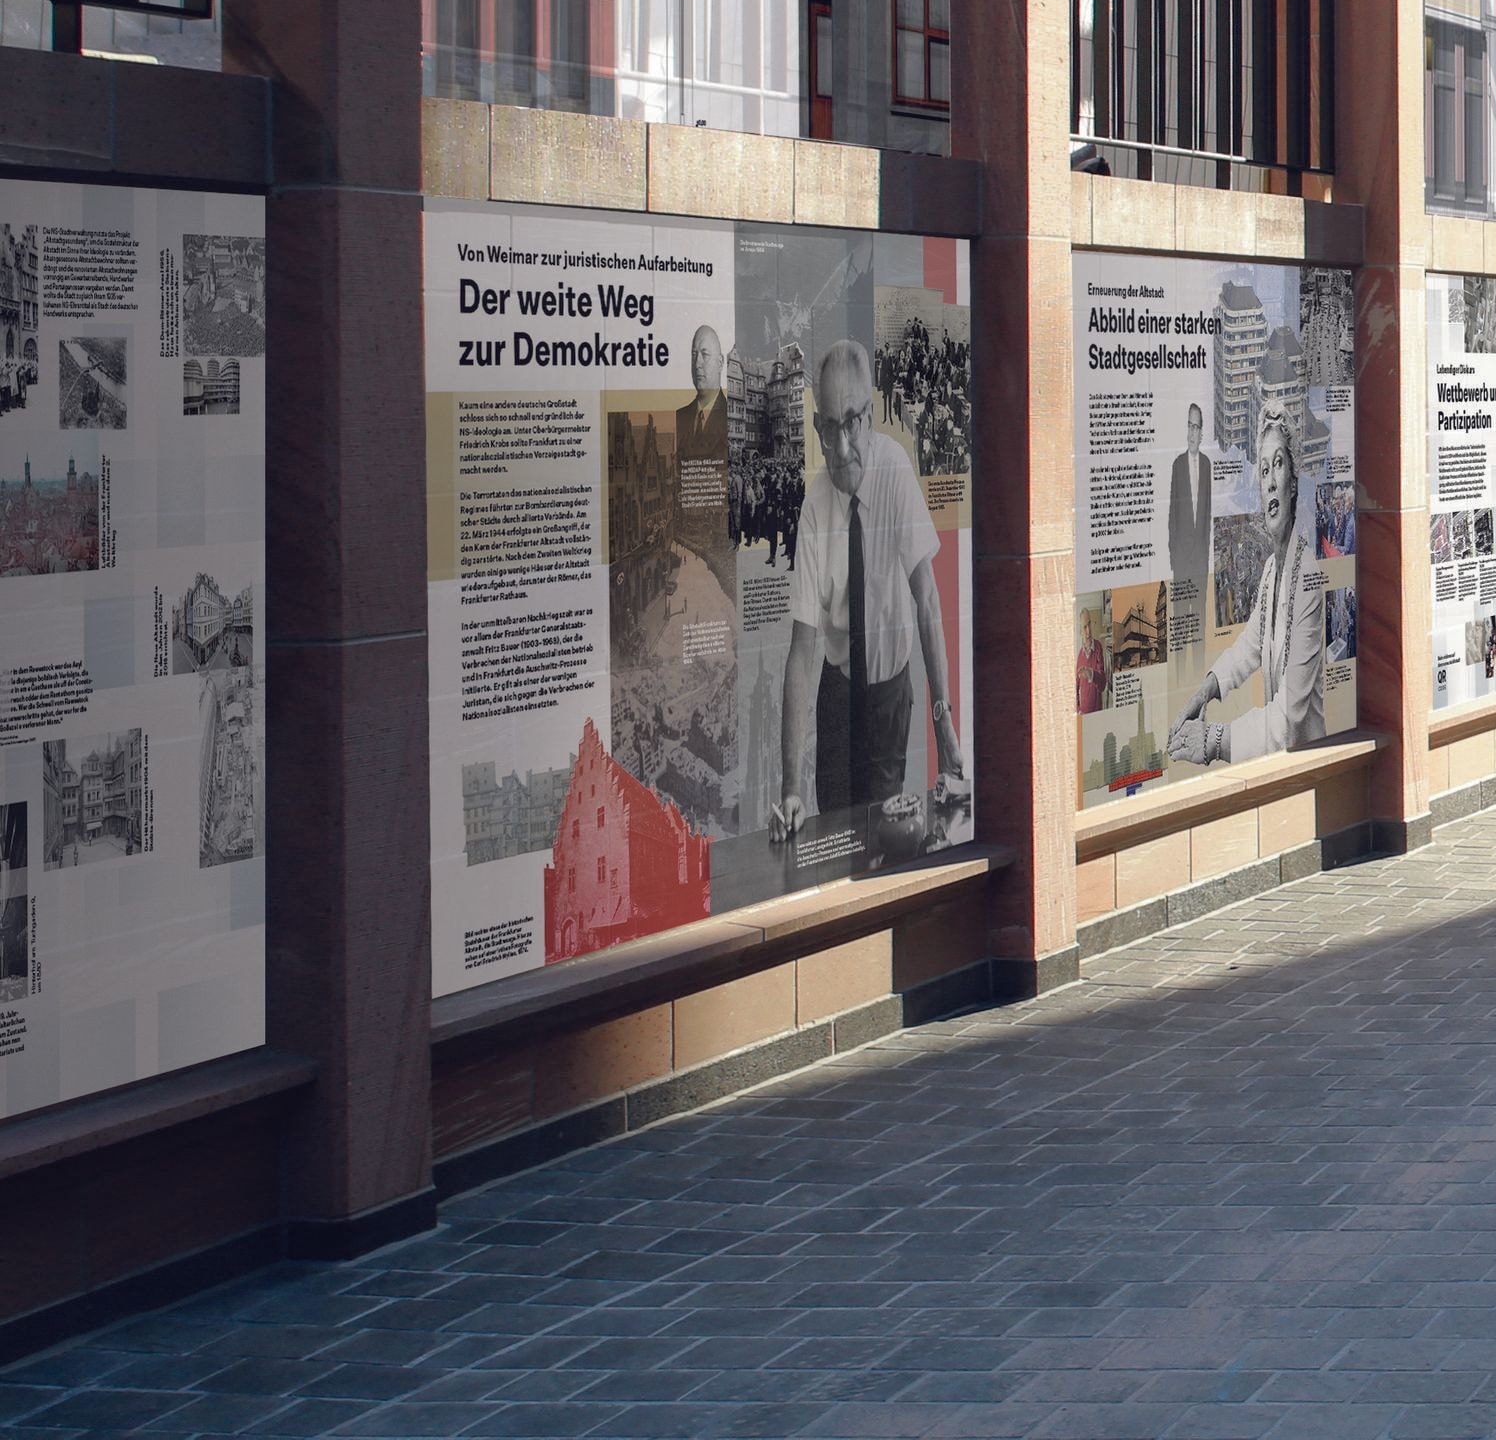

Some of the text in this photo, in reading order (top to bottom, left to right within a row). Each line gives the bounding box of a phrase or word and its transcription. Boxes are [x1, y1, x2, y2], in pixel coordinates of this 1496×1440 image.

[458, 244, 713, 276] Von Weimar zur juristischen Aufarbeitung
[1088, 282, 1164, 299] Erneuerung der Altstadt
[460, 278, 654, 326] Der weite Weg
[1088, 307, 1222, 334] Abbild einer starken
[459, 332, 669, 367] zur Demokratie
[1089, 344, 1206, 374] Stadtgesellschaft
[1437, 382, 1488, 402] Wettbewerb
[517, 400, 546, 408] deutsche
[547, 399, 577, 408] Großstadt
[459, 413, 484, 422] schloss
[485, 413, 499, 421] sich
[508, 412, 530, 421] schnell
[544, 412, 573, 422] gründlich
[574, 411, 584, 419] der
[1438, 410, 1492, 433] Partizipation
[459, 427, 502, 437] NS-Ideologie
[533, 425, 591, 435] Oberbürgermeister
[459, 440, 490, 448] Friedrich
[490, 440, 509, 448] Krebs
[510, 439, 528, 447] sollte
[529, 438, 558, 446] Frankfurt
[460, 451, 533, 461] nationalsozialistischen
[534, 450, 576, 459] Vorzeigestadt
[460, 465, 508, 474] macht werden.
[460, 492, 472, 500] Die
[473, 491, 509, 499] Terrortaten
[523, 485, 592, 496] nationalsozialistischen
[460, 506, 489, 515] Regimes
[489, 504, 514, 512] führten
[525, 500, 574, 509] Bombardierung
[575, 498, 590, 506] deut-
[460, 518, 479, 527] scher
[480, 516, 501, 525] Städte
[502, 515, 521, 523] durch
[544, 511, 575, 520] Verbände.
[460, 532, 471, 540] 22.
[489, 529, 505, 537] 1944
[506, 527, 532, 536] erfolgte
[543, 523, 579, 533] Großangriff,
[461, 544, 473, 552] den
[491, 542, 502, 550] der
[502, 539, 539, 549] Frankfurter
[540, 536, 565, 545] Altstadt
[565, 535, 591, 543] vollstän-
[1438, 670, 1446, 683] QR
